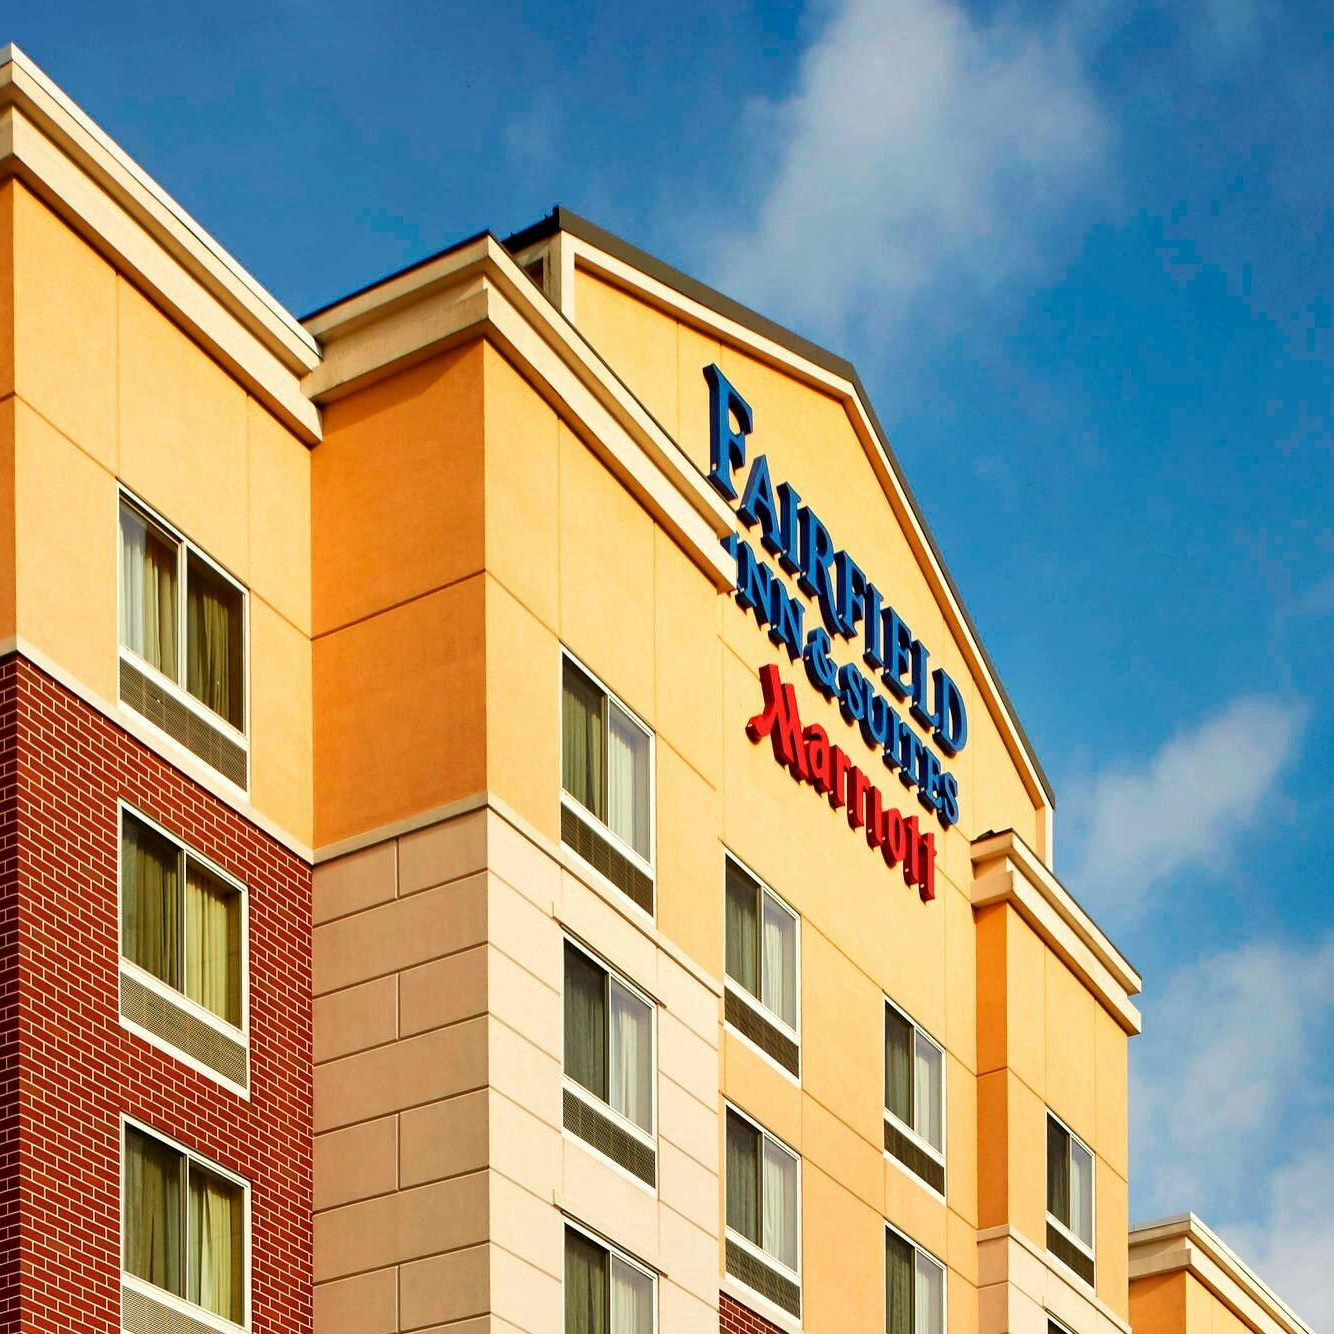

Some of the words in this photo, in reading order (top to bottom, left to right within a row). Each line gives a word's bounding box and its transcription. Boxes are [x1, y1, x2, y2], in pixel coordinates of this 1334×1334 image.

[704, 363, 967, 754] FAIRFIELD
[746, 664, 937, 902] Marriott
[803, 627, 841, 697] &
[838, 663, 959, 826] SUITES
